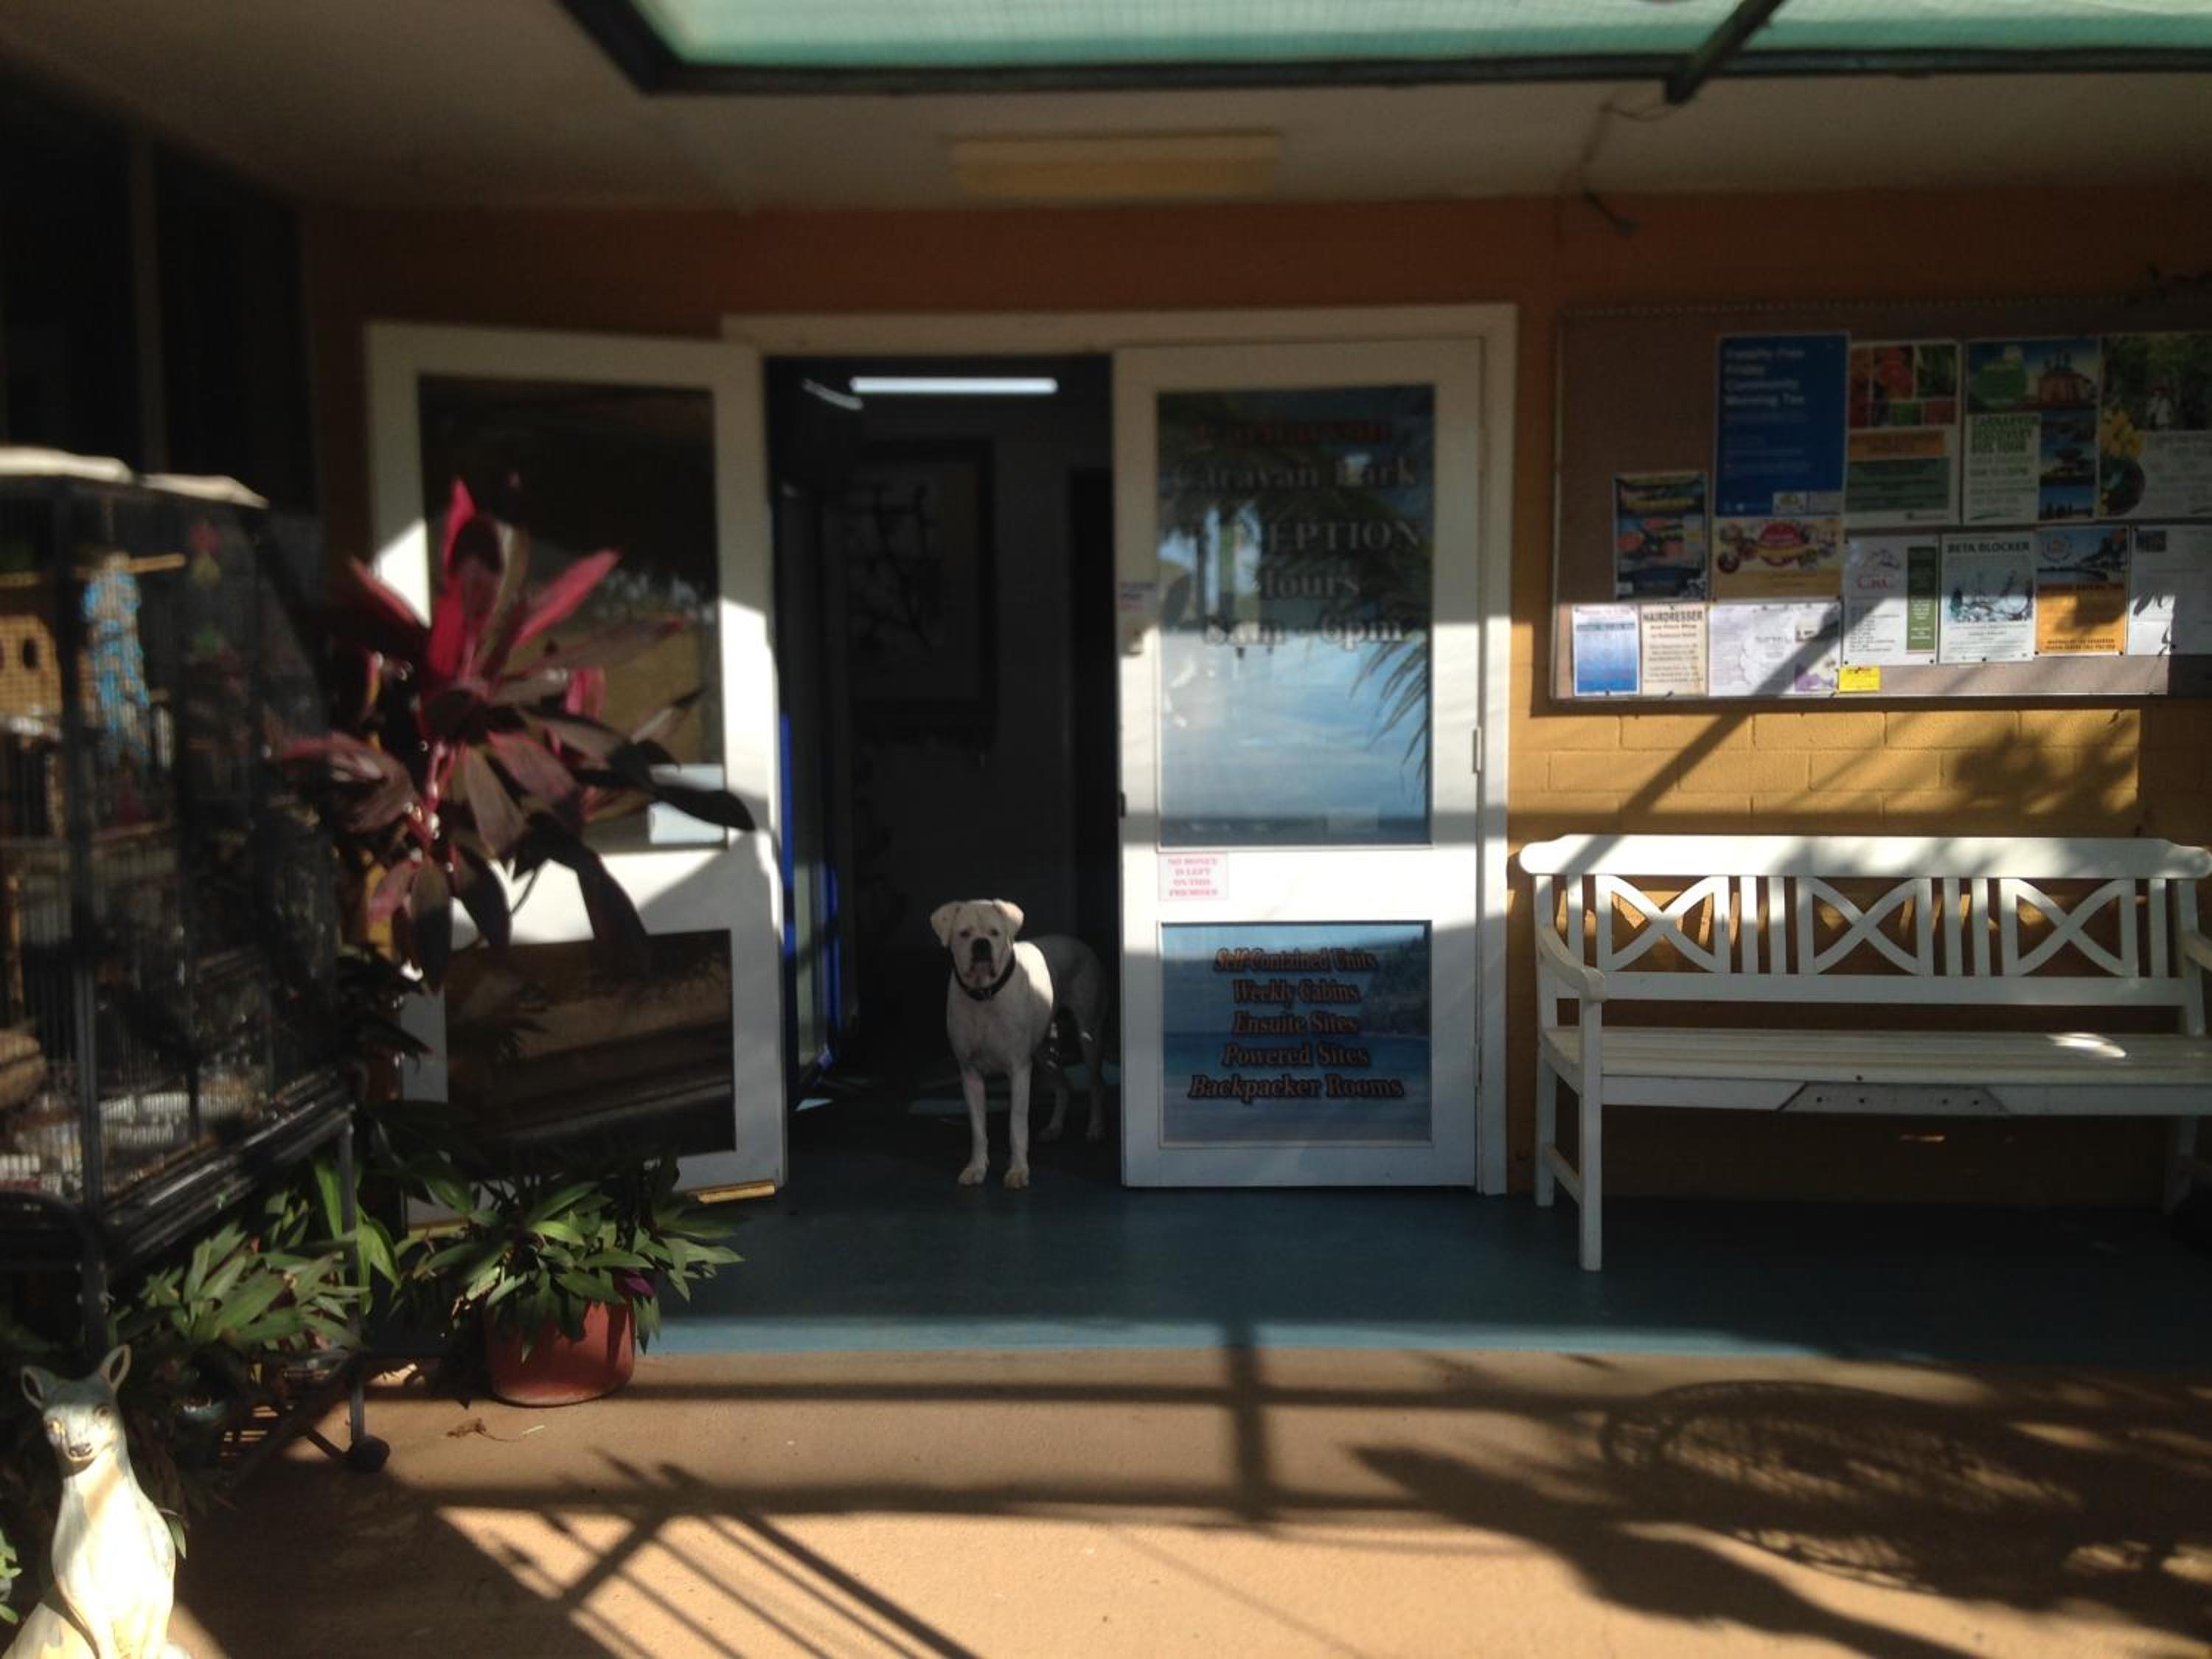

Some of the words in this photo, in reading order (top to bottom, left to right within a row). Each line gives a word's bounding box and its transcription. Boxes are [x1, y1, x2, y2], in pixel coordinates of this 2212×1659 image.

[1978, 541, 2030, 553] BLOCKER
[1642, 611, 1703, 622] HAIRDRESSER
[1186, 867, 1211, 876] LEFT
[1332, 947, 1378, 970] Units
[1234, 979, 1294, 1007] Weekly
[1298, 978, 1360, 1004] Cabins
[1234, 1010, 1306, 1035] Ensuite
[1310, 1010, 1360, 1034] Sites
[1223, 1043, 1312, 1067] Powered
[1318, 1043, 1369, 1067] Sites
[1189, 1074, 1321, 1103] Backpacker
[1326, 1074, 1405, 1098] Rooms
